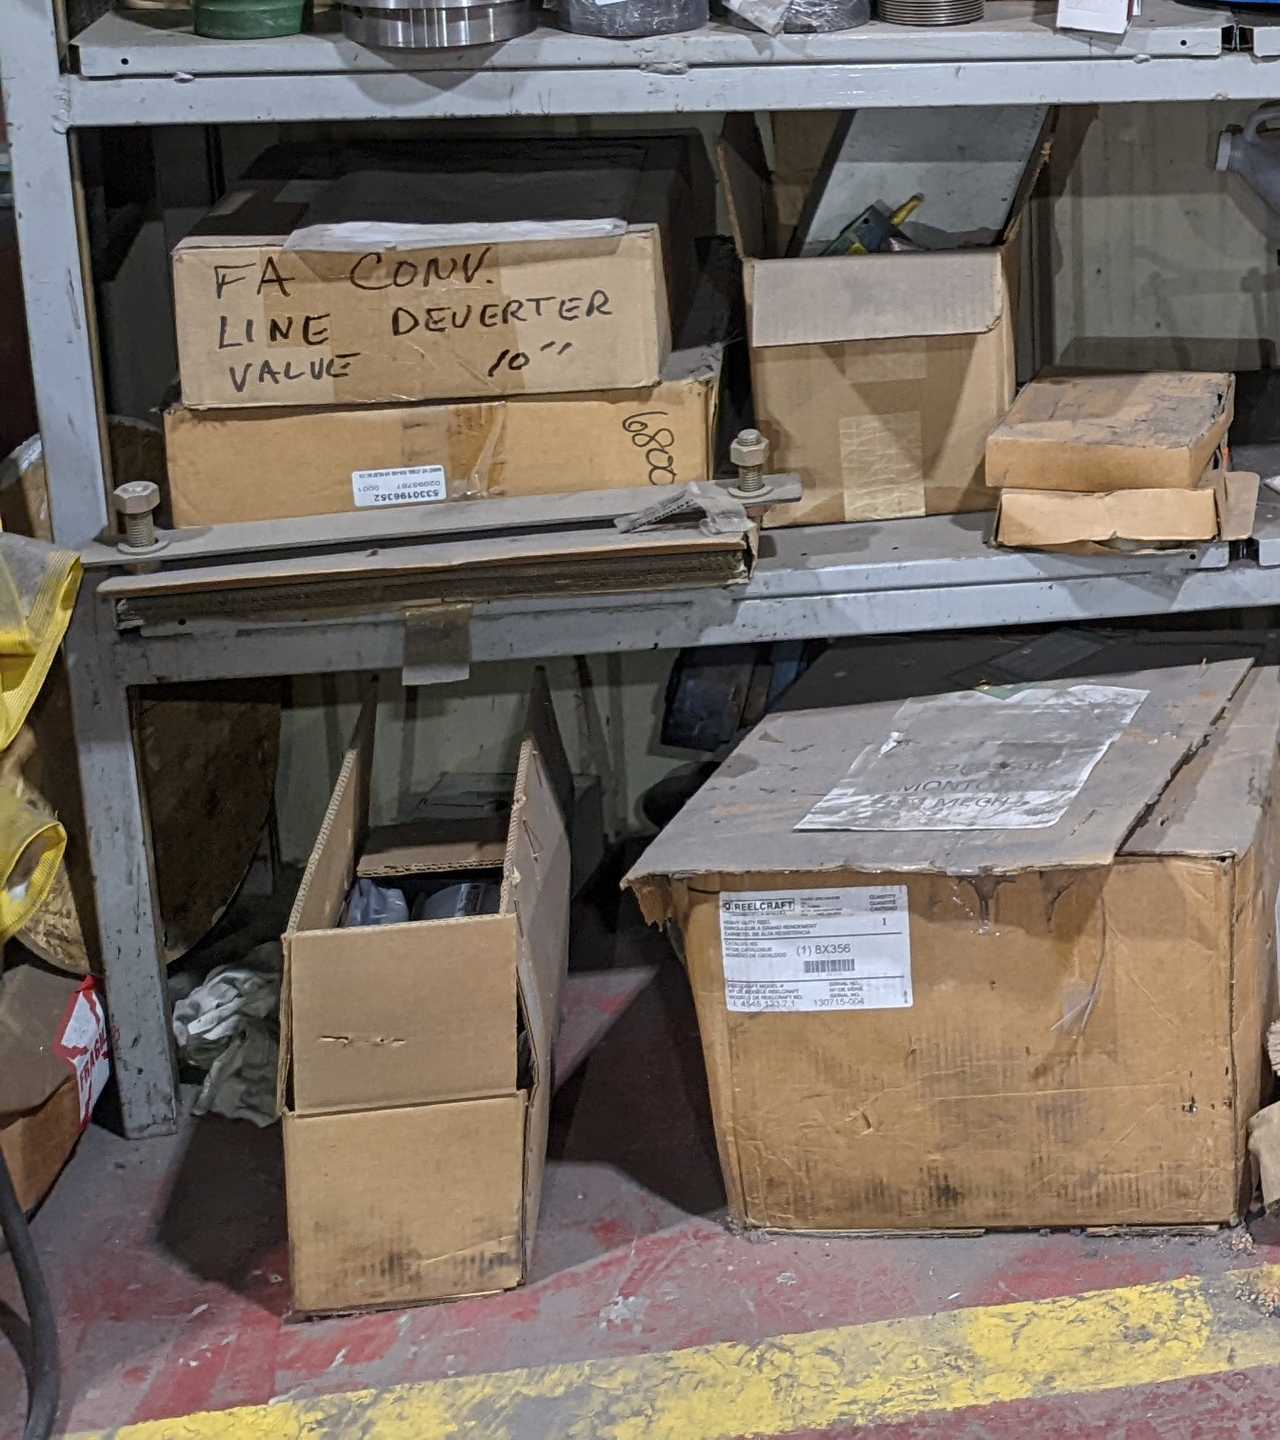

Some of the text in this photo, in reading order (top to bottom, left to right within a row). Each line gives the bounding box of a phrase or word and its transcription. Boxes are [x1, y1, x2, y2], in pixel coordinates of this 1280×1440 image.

[213, 246, 496, 301] FA CONV.
[217, 312, 331, 350] LINE
[734, 902, 793, 911] REELCRAFT
